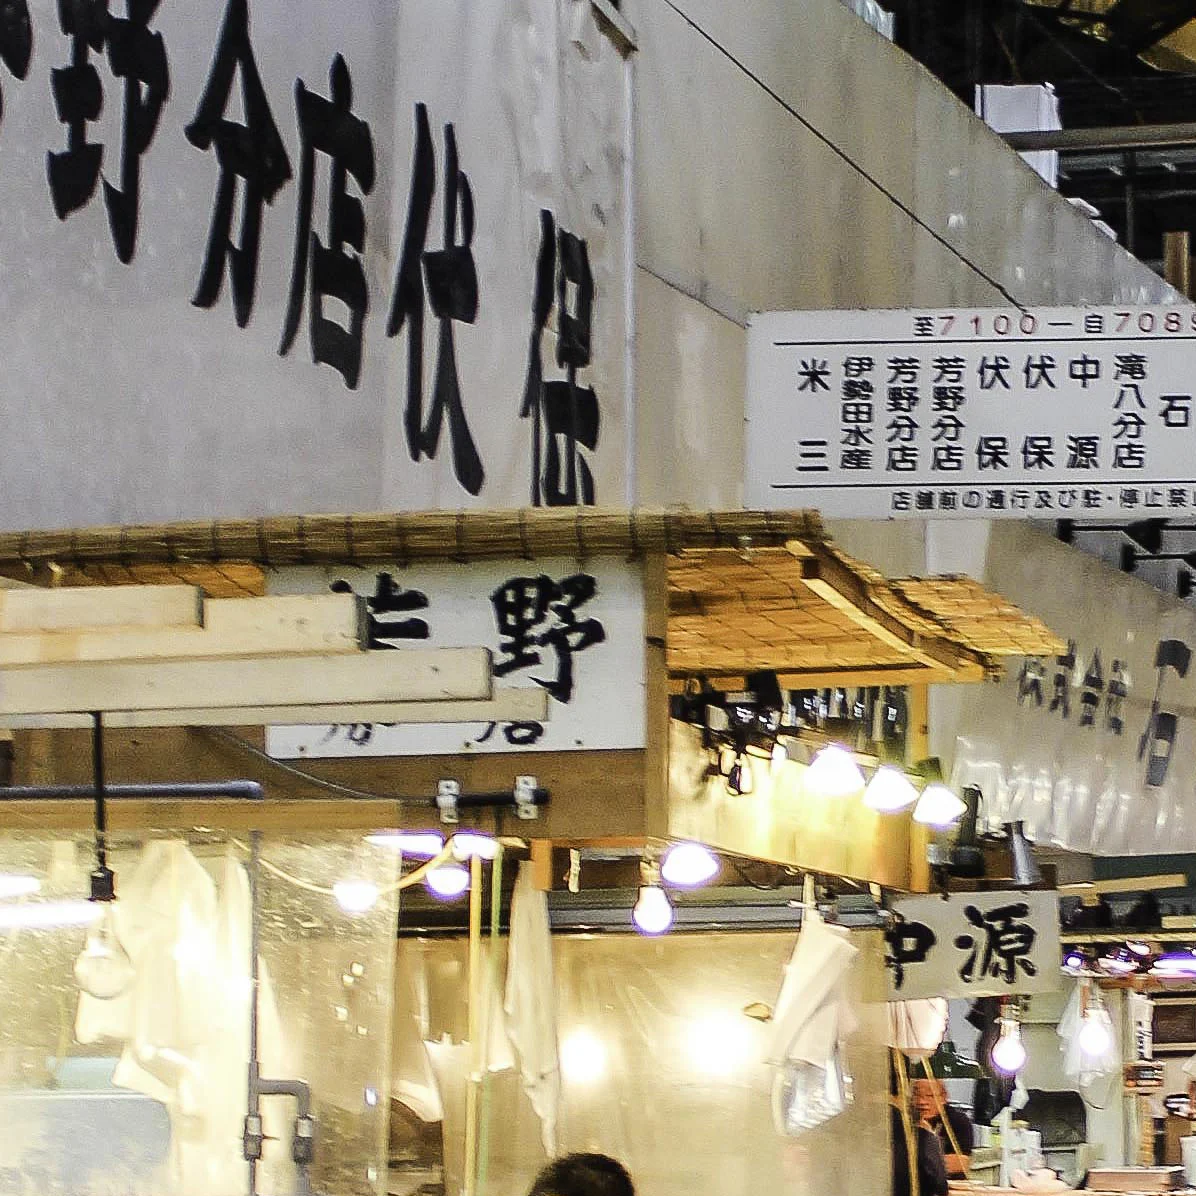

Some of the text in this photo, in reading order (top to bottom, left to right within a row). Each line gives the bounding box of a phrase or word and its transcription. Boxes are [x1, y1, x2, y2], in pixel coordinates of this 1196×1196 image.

[0, 0, 374, 390] 野分店
[886, 356, 921, 471] 芳野分店
[932, 356, 966, 471] 芳野分店
